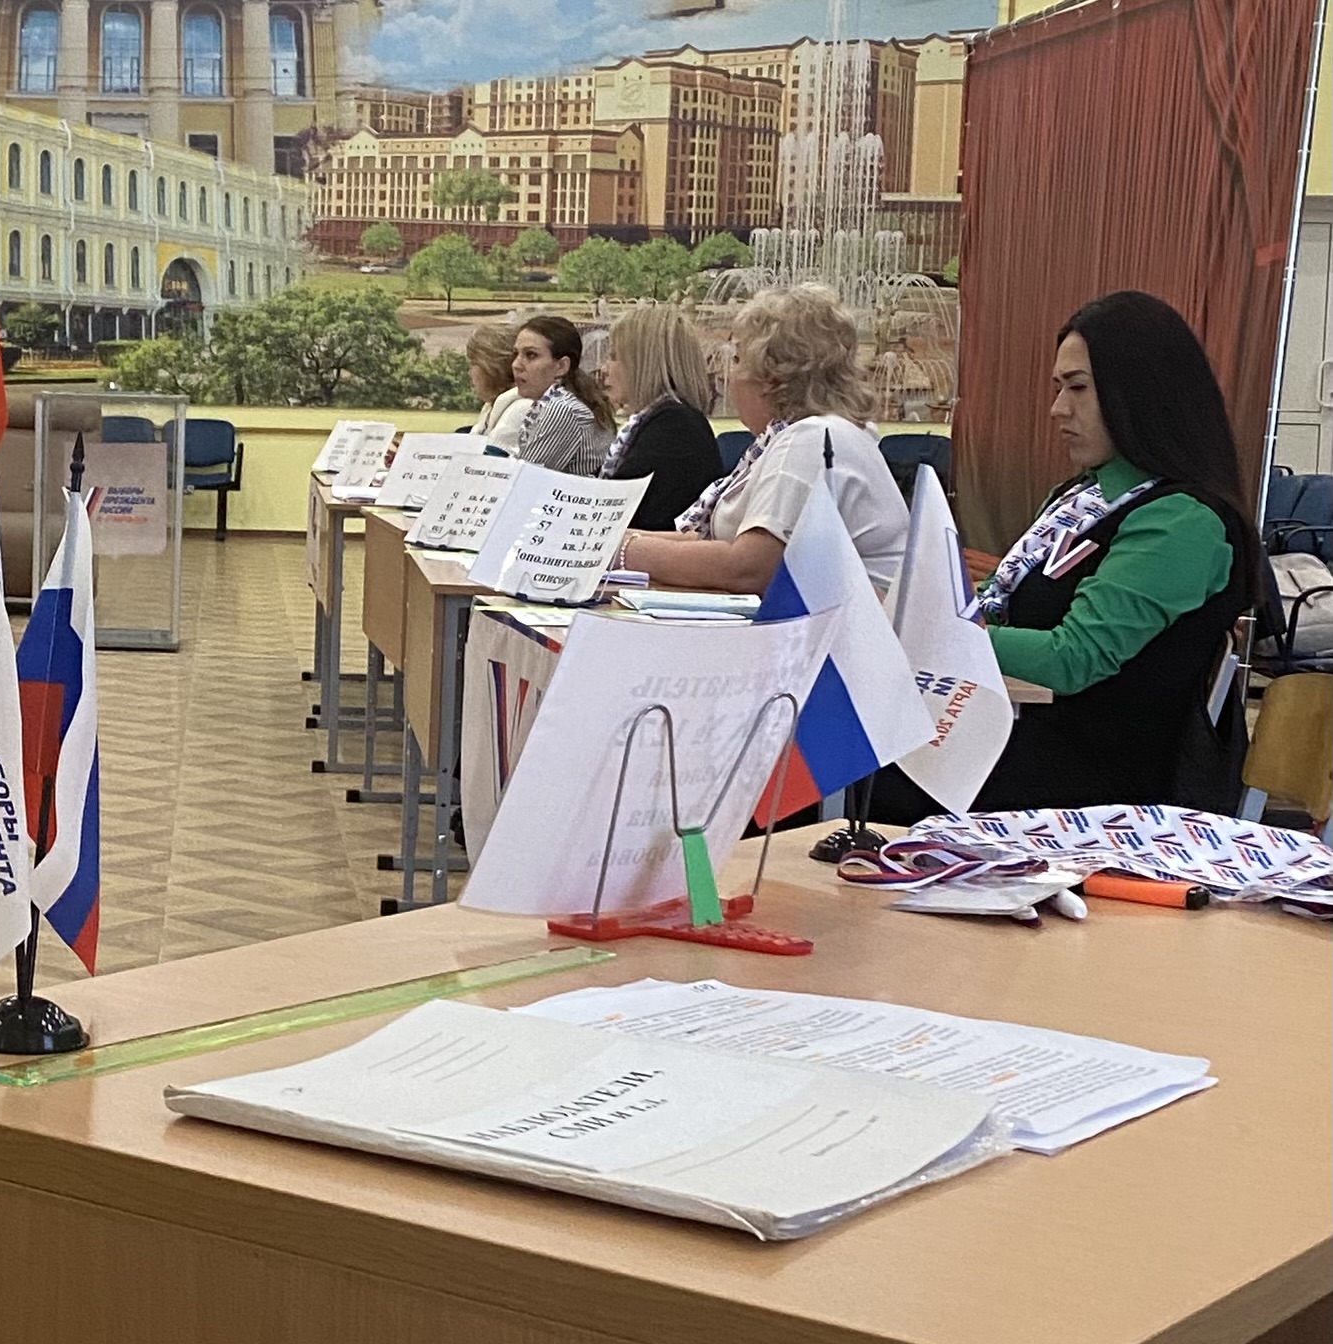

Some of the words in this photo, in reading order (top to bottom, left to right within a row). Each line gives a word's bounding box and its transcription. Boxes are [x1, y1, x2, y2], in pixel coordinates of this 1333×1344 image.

[552, 488, 592, 506] Чехова
[542, 504, 563, 518] 55/1
[573, 513, 587, 521] кв.
[591, 512, 603, 522] 91
[537, 520, 552, 531] 57
[569, 528, 584, 536] кв.
[530, 535, 545, 546] 59
[562, 543, 576, 551] кв.
[578, 542, 586, 552] 3
[549, 1116, 615, 1140] СМИ
